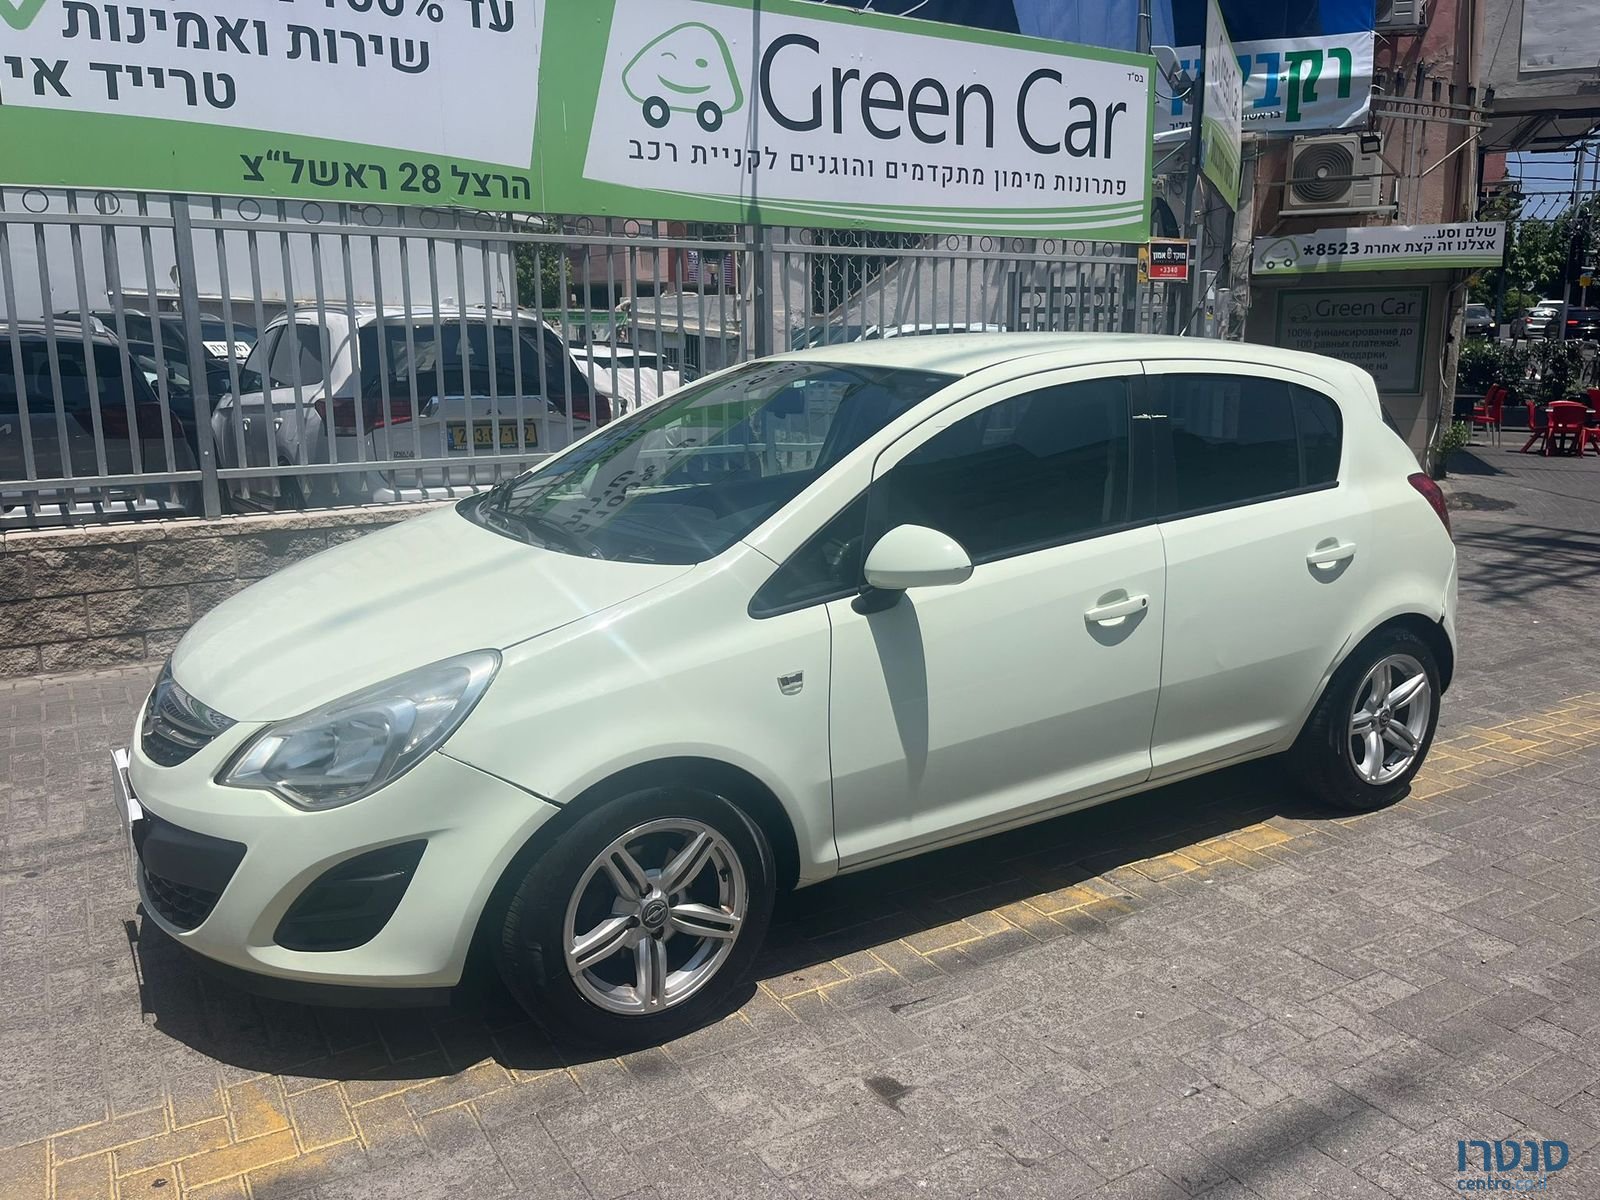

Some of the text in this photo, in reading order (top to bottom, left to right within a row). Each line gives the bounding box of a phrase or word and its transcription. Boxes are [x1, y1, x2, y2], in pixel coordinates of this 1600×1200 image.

[62, 0, 268, 56] ואמינות
[287, 24, 430, 73] שירות
[89, 62, 236, 109] טרייד
[760, 33, 994, 148] Green
[1017, 68, 1127, 159] Car
[399, 162, 441, 193] 28
[629, 139, 1127, 195] פתרונות מימון מתקדמים והוגנים לקניית רכב
[450, 164, 530, 200] הרצל
[1424, 227, 1496, 240] שלם וסע...
[1437, 240, 1453, 251] זה
[1457, 239, 1495, 251] אצלנו
[1364, 243, 1400, 254] אחרת
[1405, 242, 1433, 254] קצת
[1315, 297, 1416, 317] Green Car
[1400, 328, 1413, 337] до
